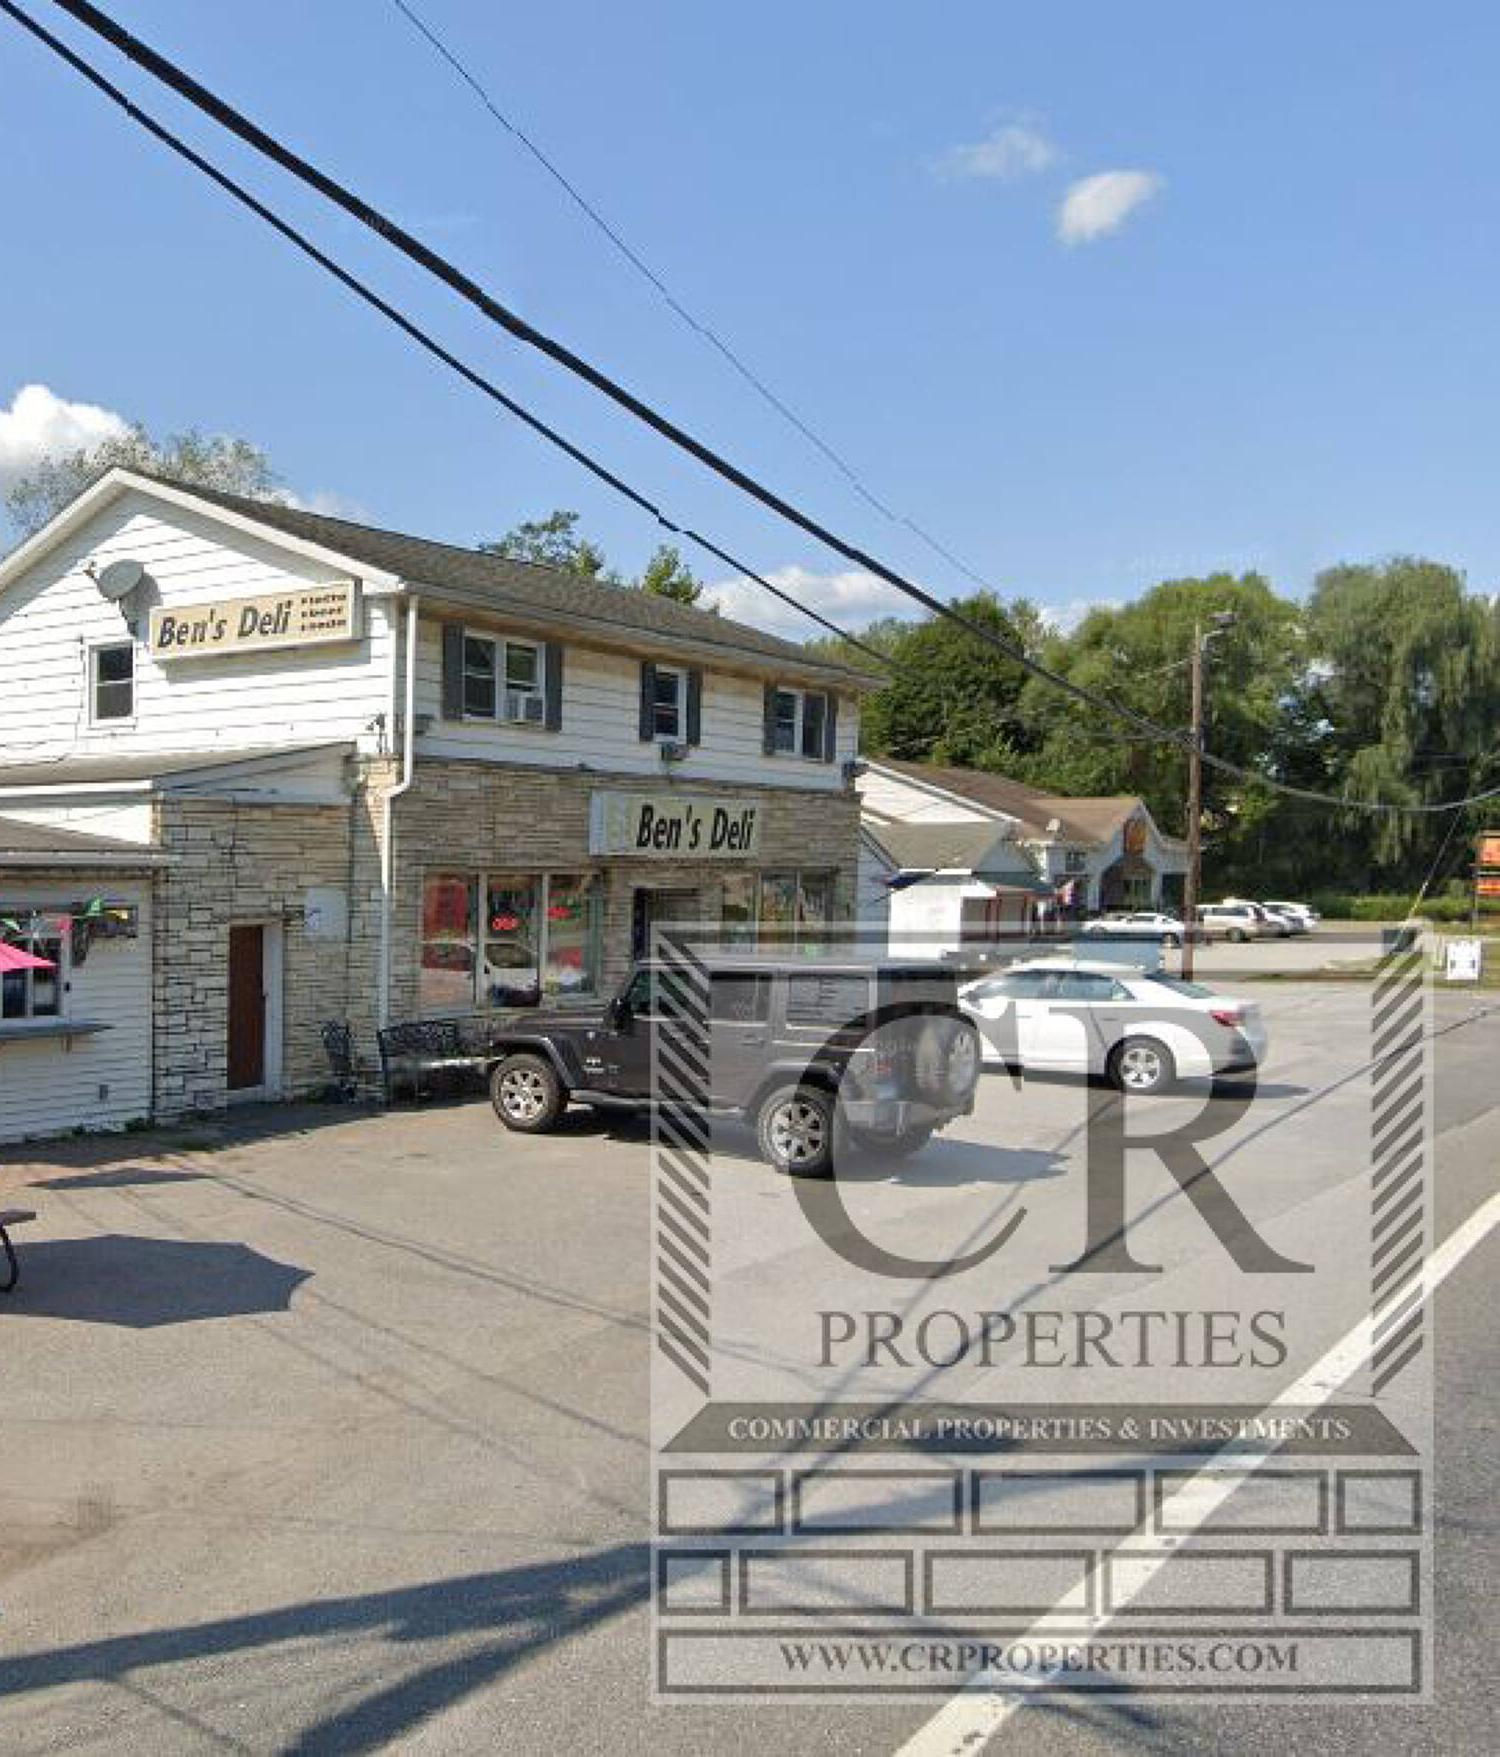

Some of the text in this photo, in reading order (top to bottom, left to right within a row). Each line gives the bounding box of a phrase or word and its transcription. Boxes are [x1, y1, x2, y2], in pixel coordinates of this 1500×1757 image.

[158, 599, 294, 648] Ben's Deli
[636, 804, 756, 850] Ben's Deli
